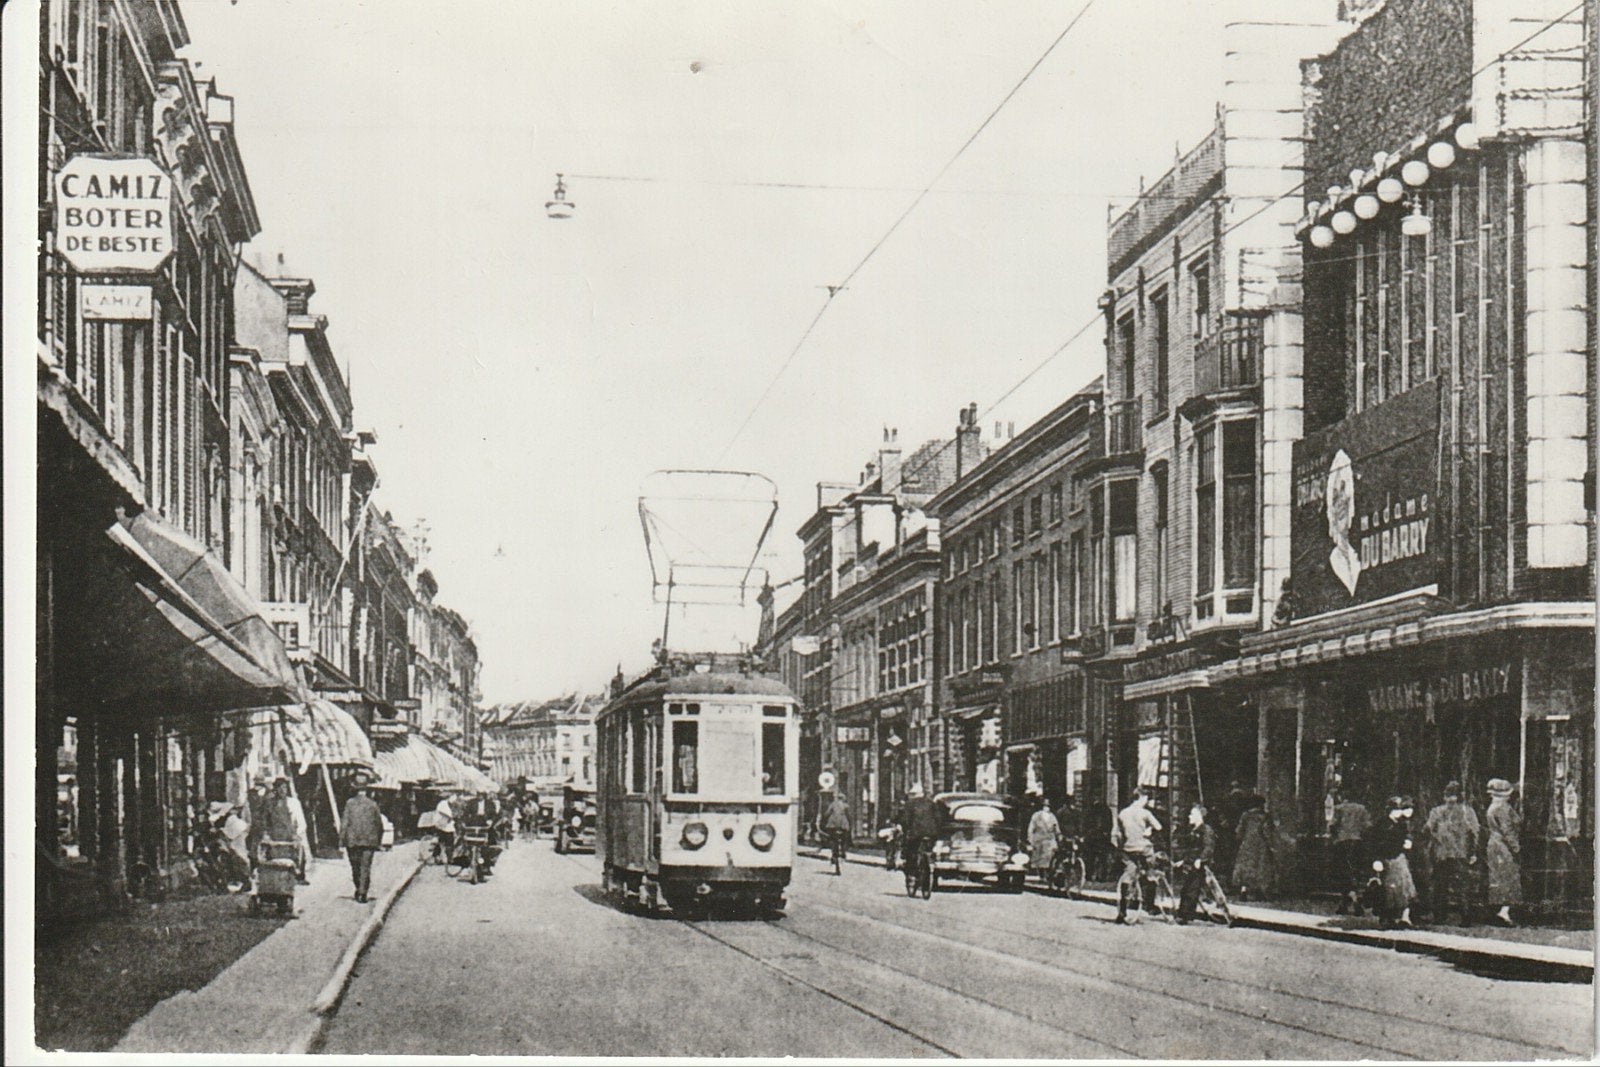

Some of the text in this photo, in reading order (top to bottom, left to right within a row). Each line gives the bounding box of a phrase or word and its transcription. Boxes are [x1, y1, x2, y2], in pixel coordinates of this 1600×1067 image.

[65, 207, 163, 228] BOTER
[66, 235, 163, 252] DE BESTE
